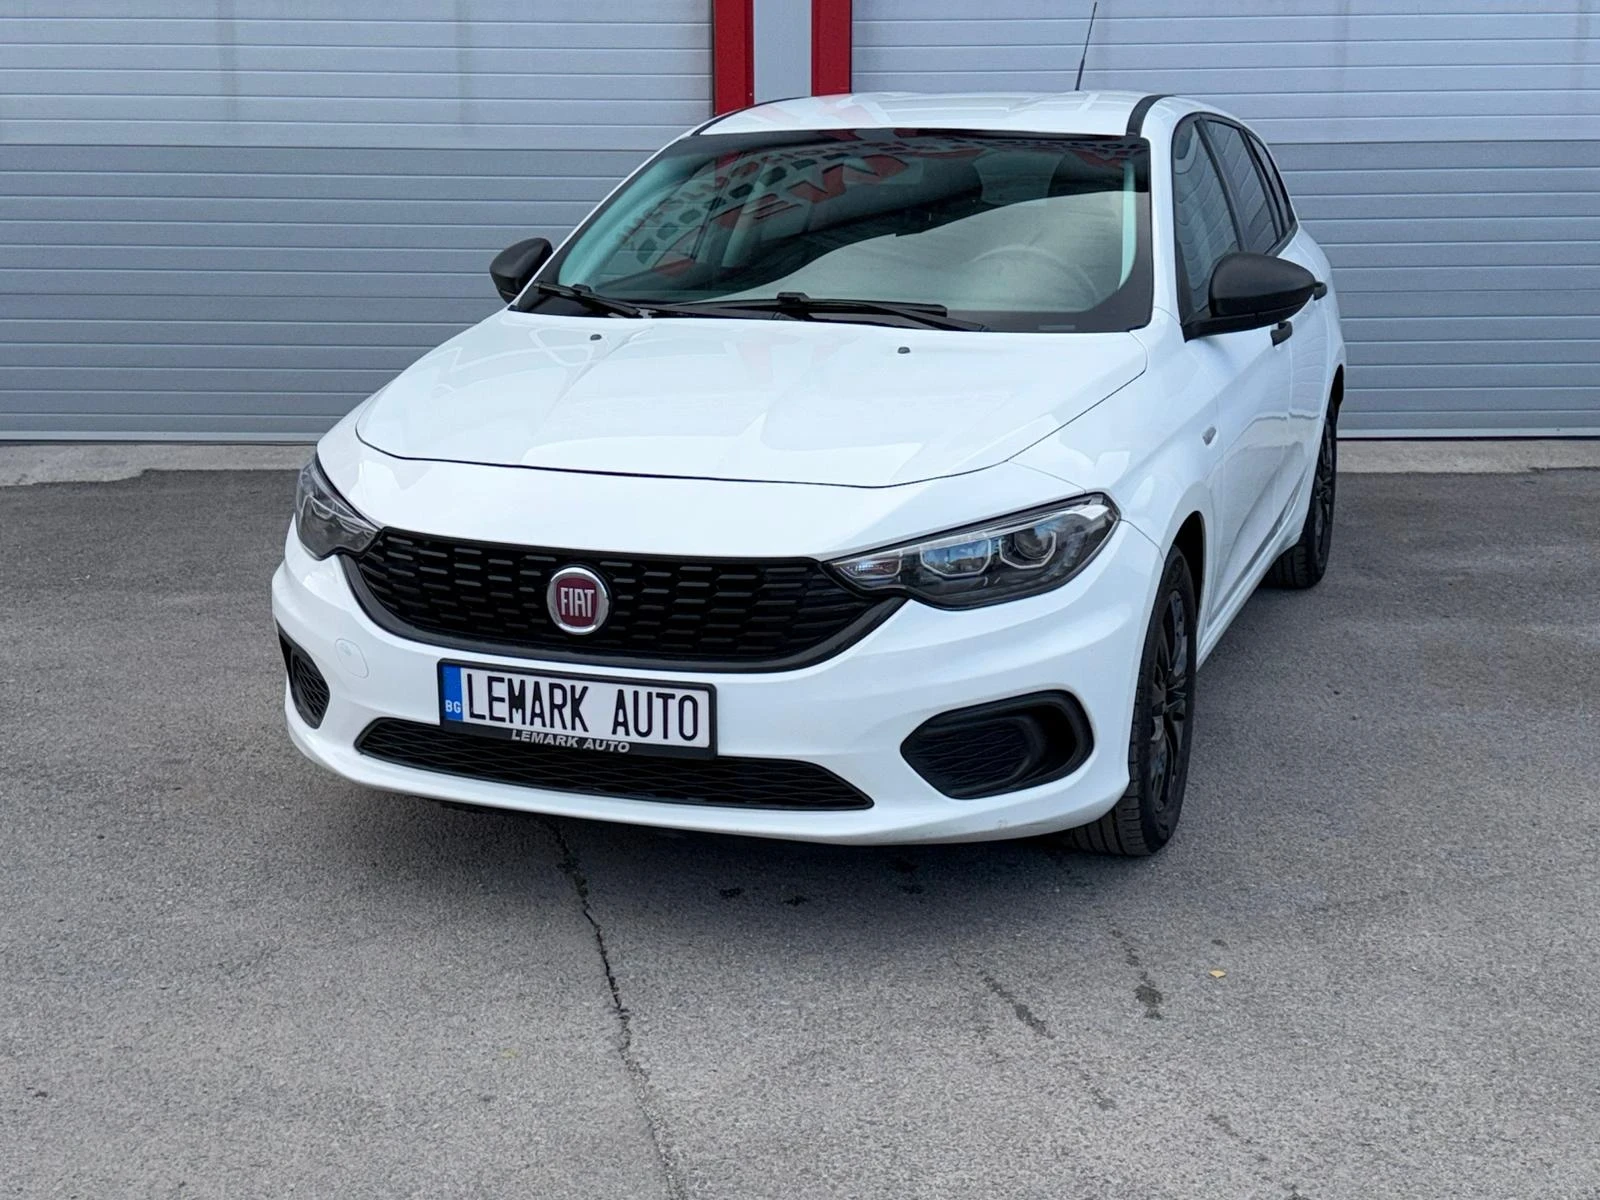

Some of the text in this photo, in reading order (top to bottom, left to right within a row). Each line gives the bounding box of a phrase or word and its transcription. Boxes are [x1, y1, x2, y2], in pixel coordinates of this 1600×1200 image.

[560, 587, 595, 617] FIAT
[445, 699, 461, 713] BG
[466, 673, 699, 741] LEMARK AUTO
[511, 729, 630, 753] LEMARK AUTO
